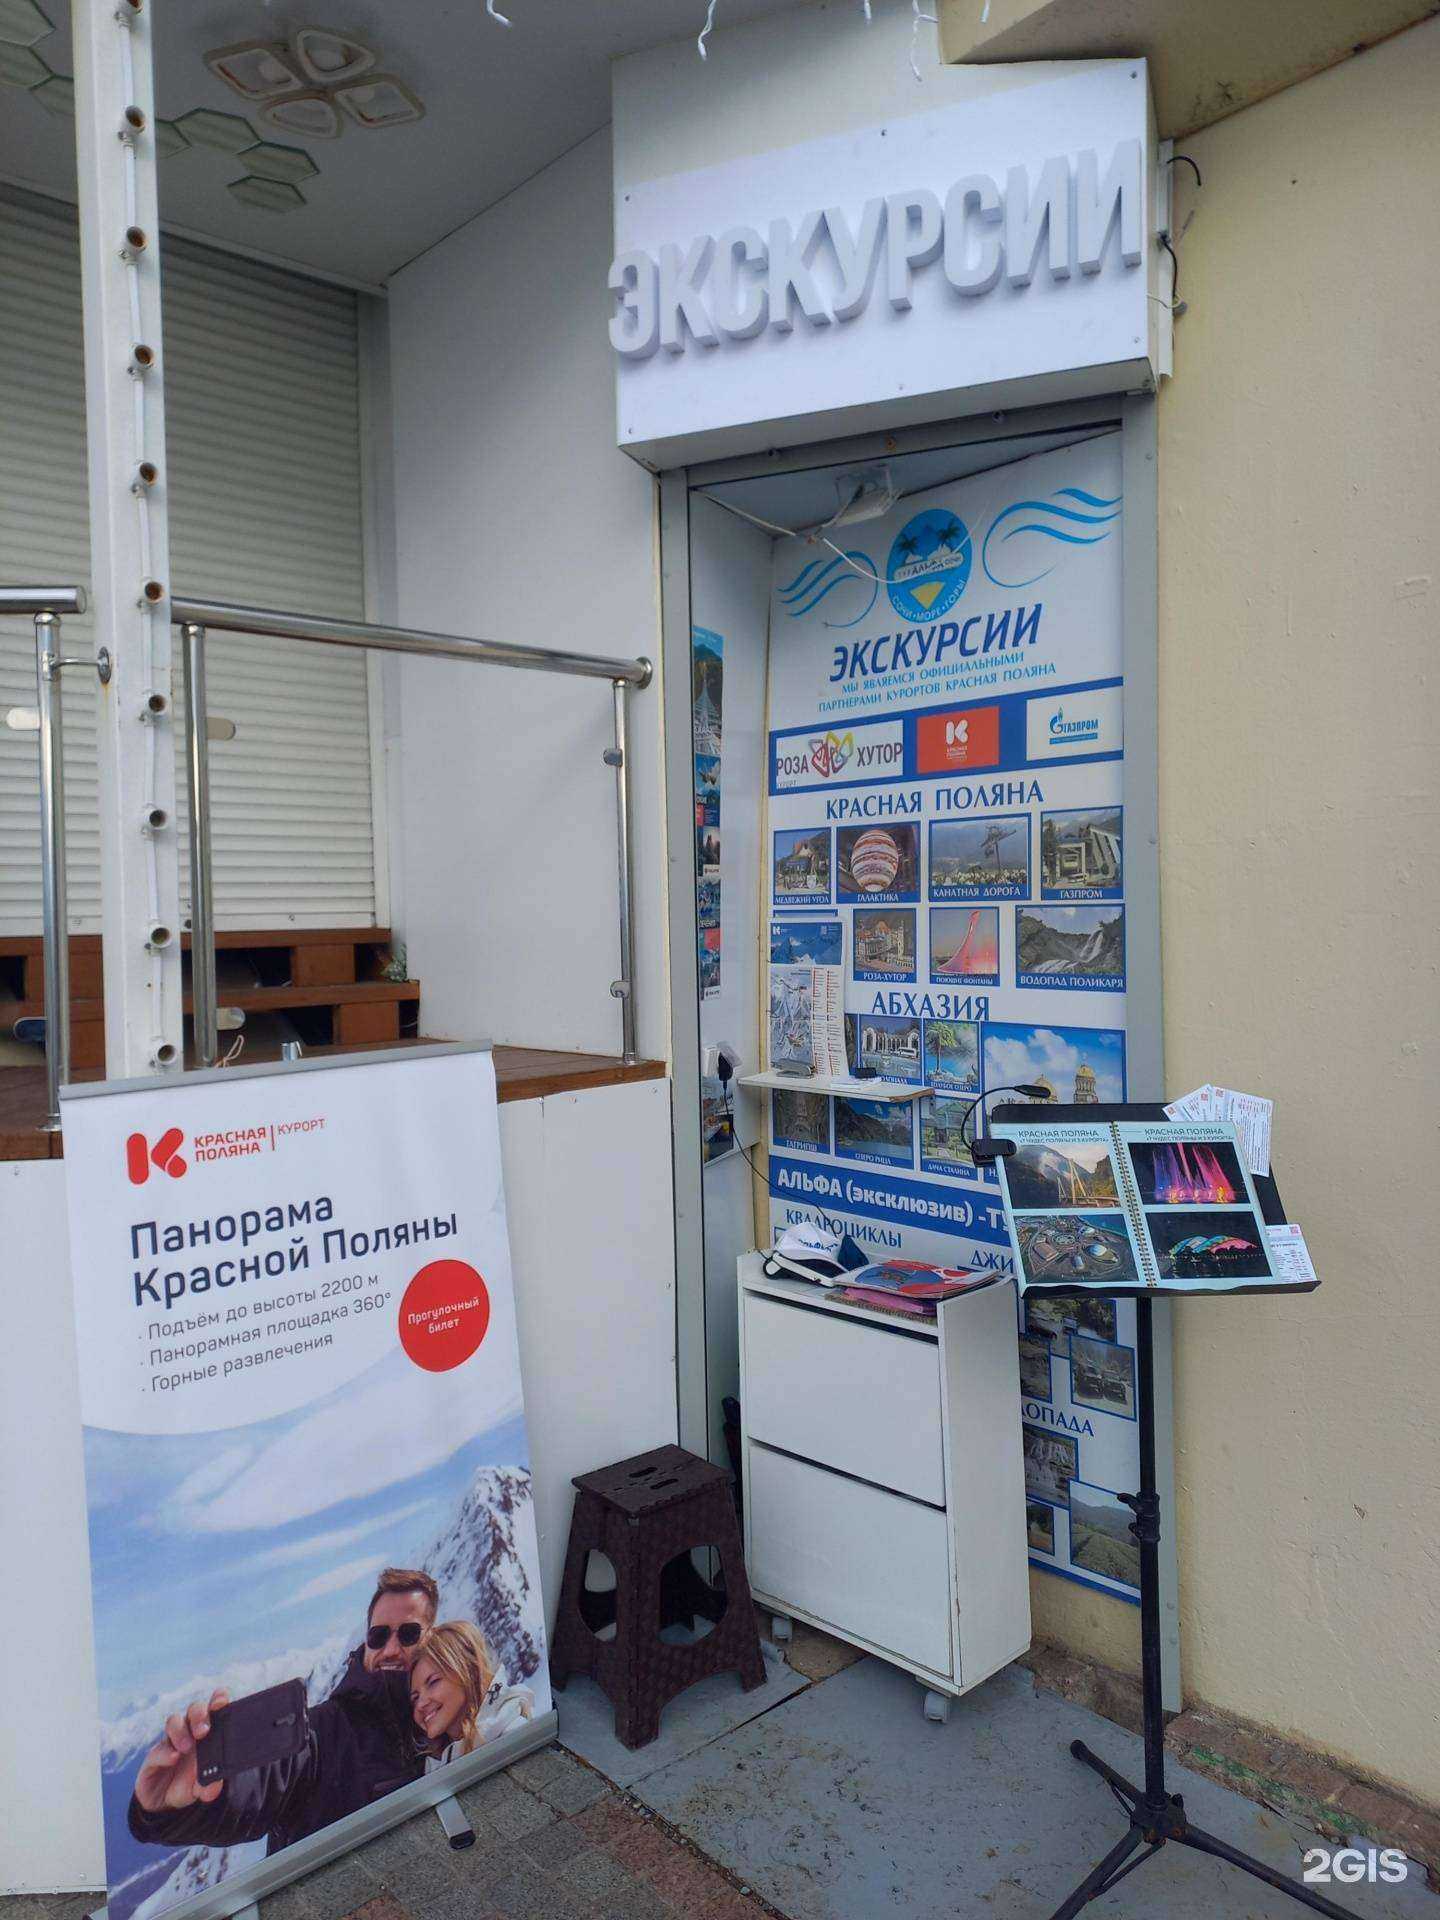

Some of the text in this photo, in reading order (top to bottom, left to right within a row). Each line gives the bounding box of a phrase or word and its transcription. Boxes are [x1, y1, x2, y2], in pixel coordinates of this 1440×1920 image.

[608, 140, 1142, 360] ЭКСКУРСИИ
[829, 603, 1042, 682] ЭКСКУРСИИ
[818, 662, 1057, 713] ПАРТНЕРАМИ КУРОРТОВ КРАСНАЯ ПОЛЯНА
[842, 651, 1025, 694] МЫ ЯВЛЯЕМСЯ ОФИЦИАЛЬНЫМИ
[776, 742, 904, 776] РОЗА ХУТОР
[826, 779, 1044, 819] КРАСНАЯ ПОЛЯНА
[857, 893, 899, 902] ГАЛАКТИКА
[933, 886, 1021, 898] КАНАТНАЯ ДОРОГА
[1060, 888, 1103, 899] ГАЗПРОМ
[863, 972, 907, 982] РОЗА-ХУТОР
[1020, 975, 1124, 989] ВОДОПАД ПОЛИКАРЯ
[872, 991, 990, 1020] АБХАЗИЯ
[194, 1127, 267, 1148] КРАСНАЯ
[278, 1118, 325, 1135] КУРОРТ
[1018, 1128, 1100, 1138] КРАСНАЯ ПОЛЯНА
[1144, 1127, 1225, 1136] КРАСНАЯ ПОЛЯНА
[195, 1142, 260, 1162] ПОЛЯНА
[777, 1168, 843, 1198] АЛЬФА
[846, 1179, 974, 1227] (эксклюзив)
[131, 1196, 333, 1259] Панорама
[786, 1208, 902, 1248] КВАДРОЦИКЛЫ
[134, 1213, 458, 1309] Красной Поляны
[149, 1273, 379, 1340] Подъём до высоты 2200 м
[407, 1296, 480, 1326] Прогулочный
[150, 1292, 392, 1366] Панорамная площадка 360°
[428, 1319, 460, 1334] билет
[152, 1334, 333, 1392] Горные развлечения
